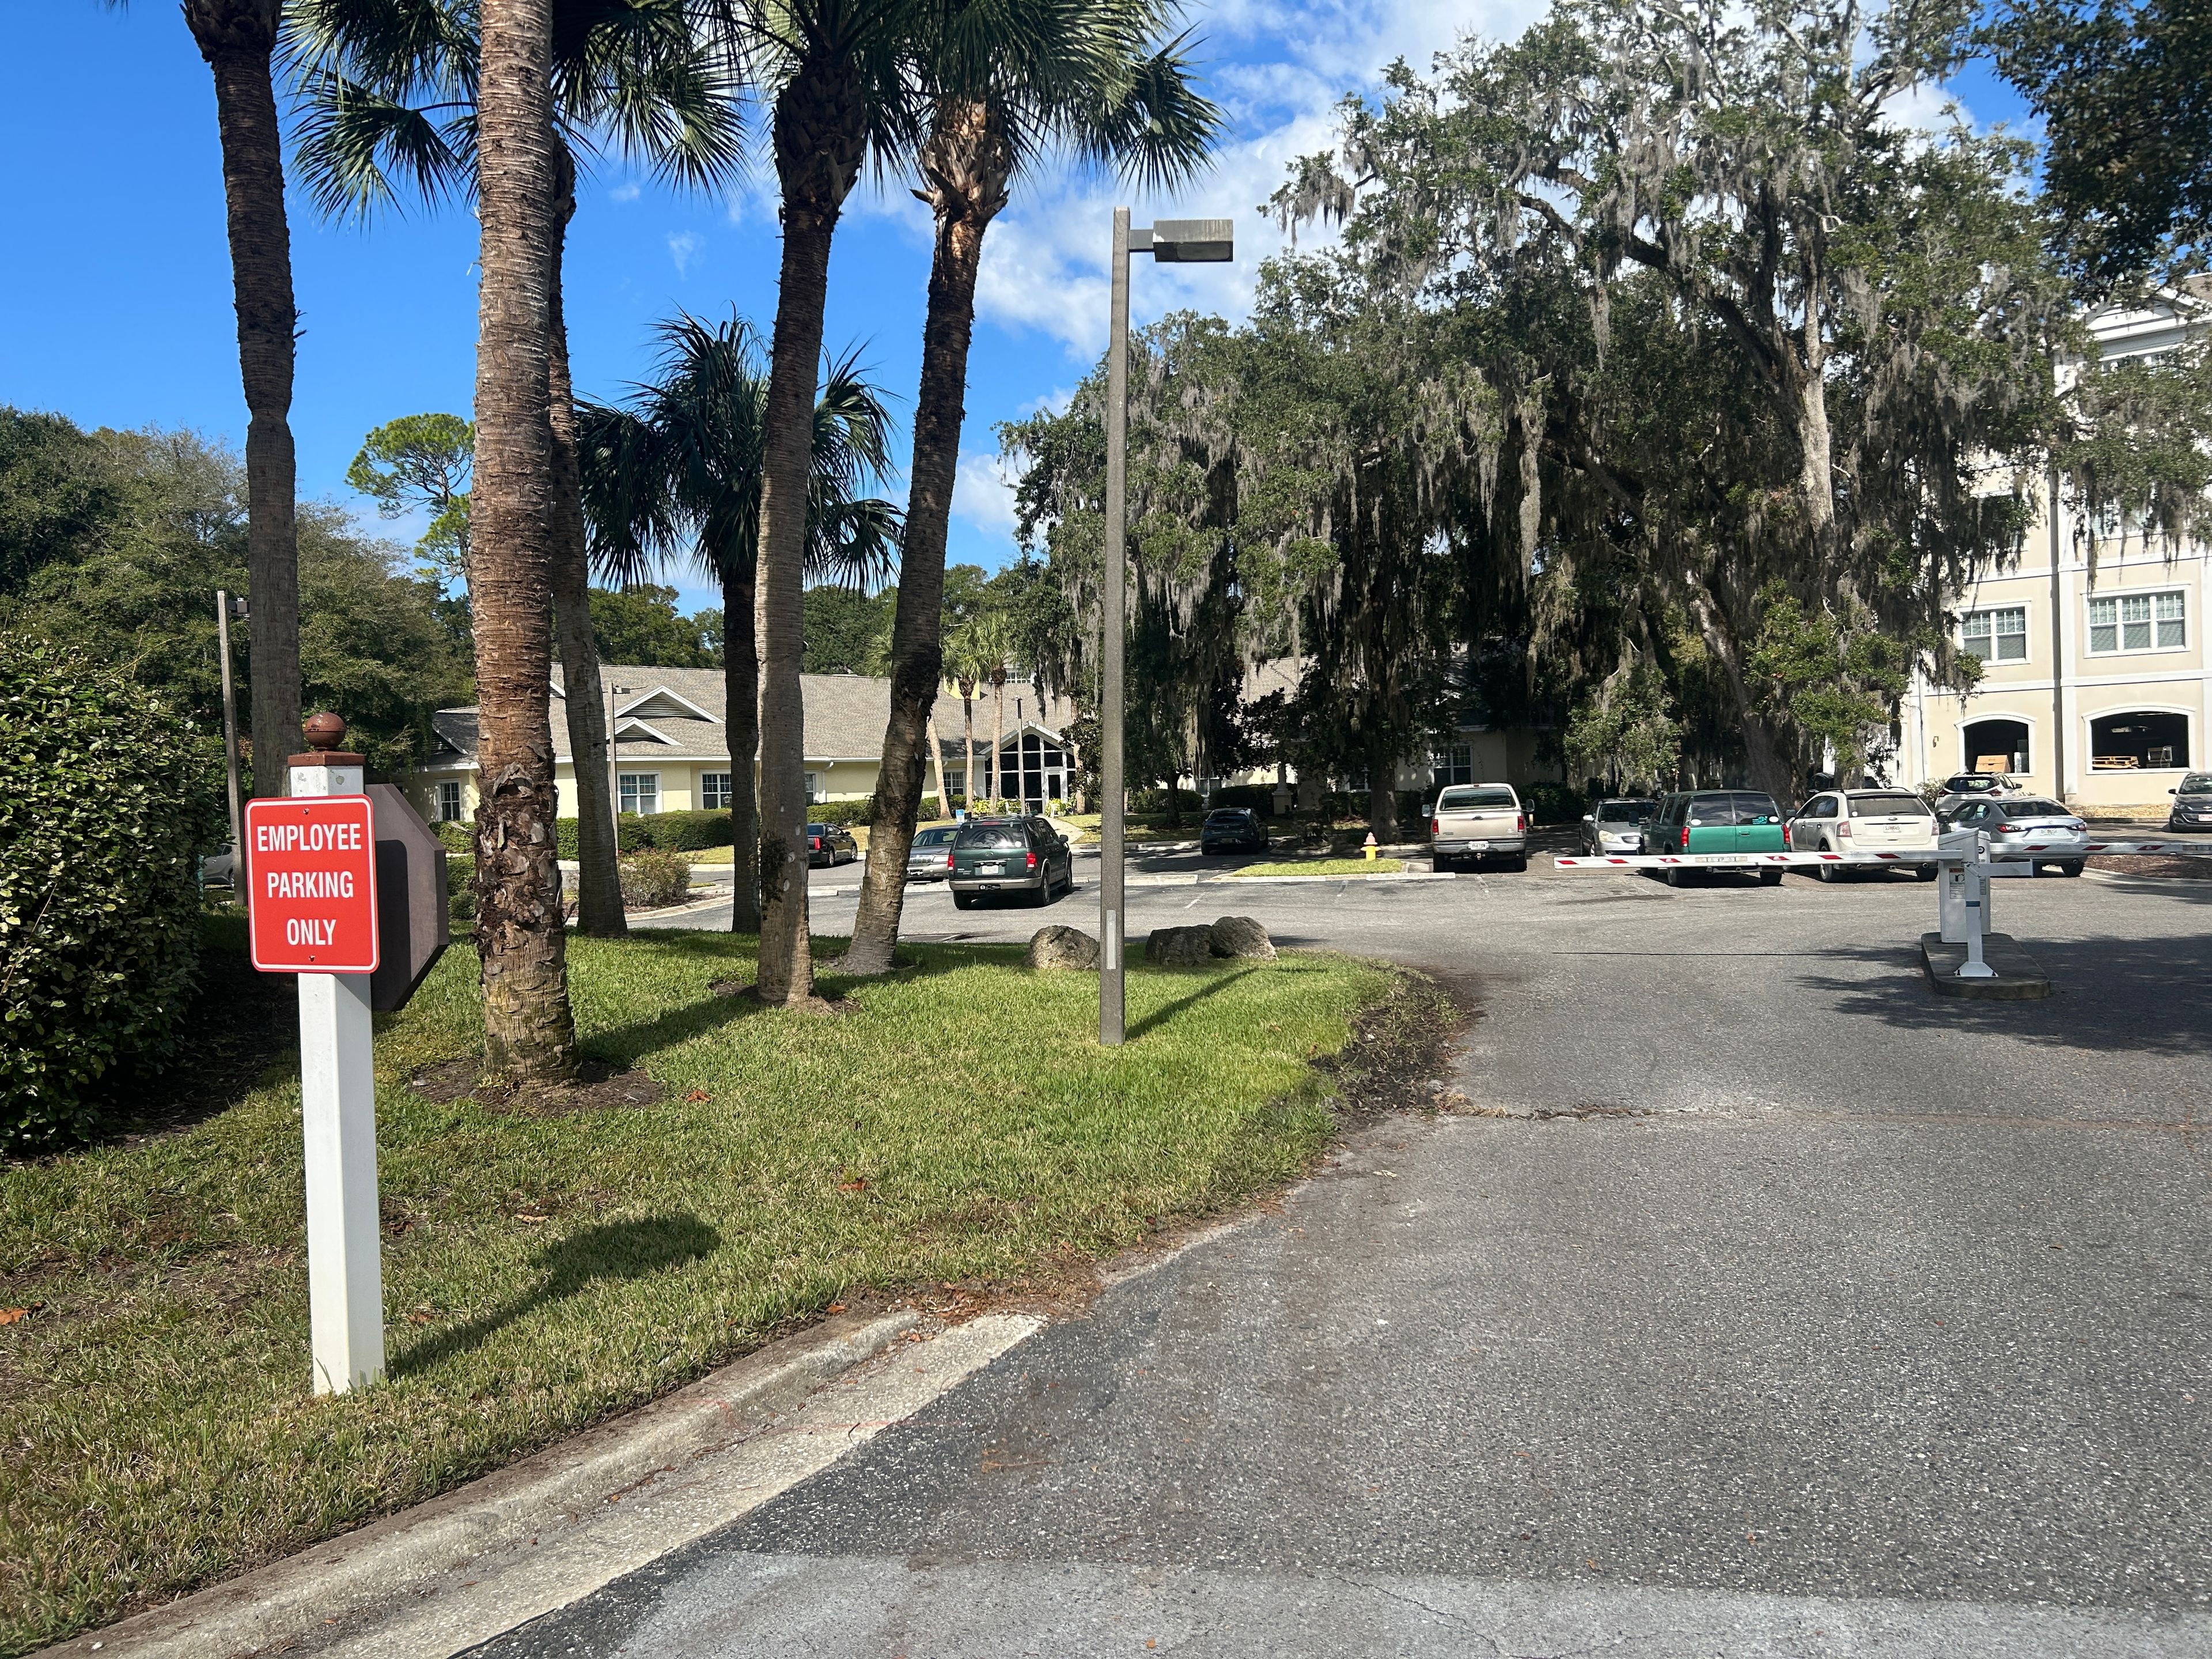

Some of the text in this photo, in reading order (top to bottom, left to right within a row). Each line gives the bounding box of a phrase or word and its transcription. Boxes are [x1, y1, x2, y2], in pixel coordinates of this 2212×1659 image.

[257, 824, 361, 851] EMPLOYEE
[268, 872, 353, 898] PARKING
[287, 919, 336, 945] ONLY
